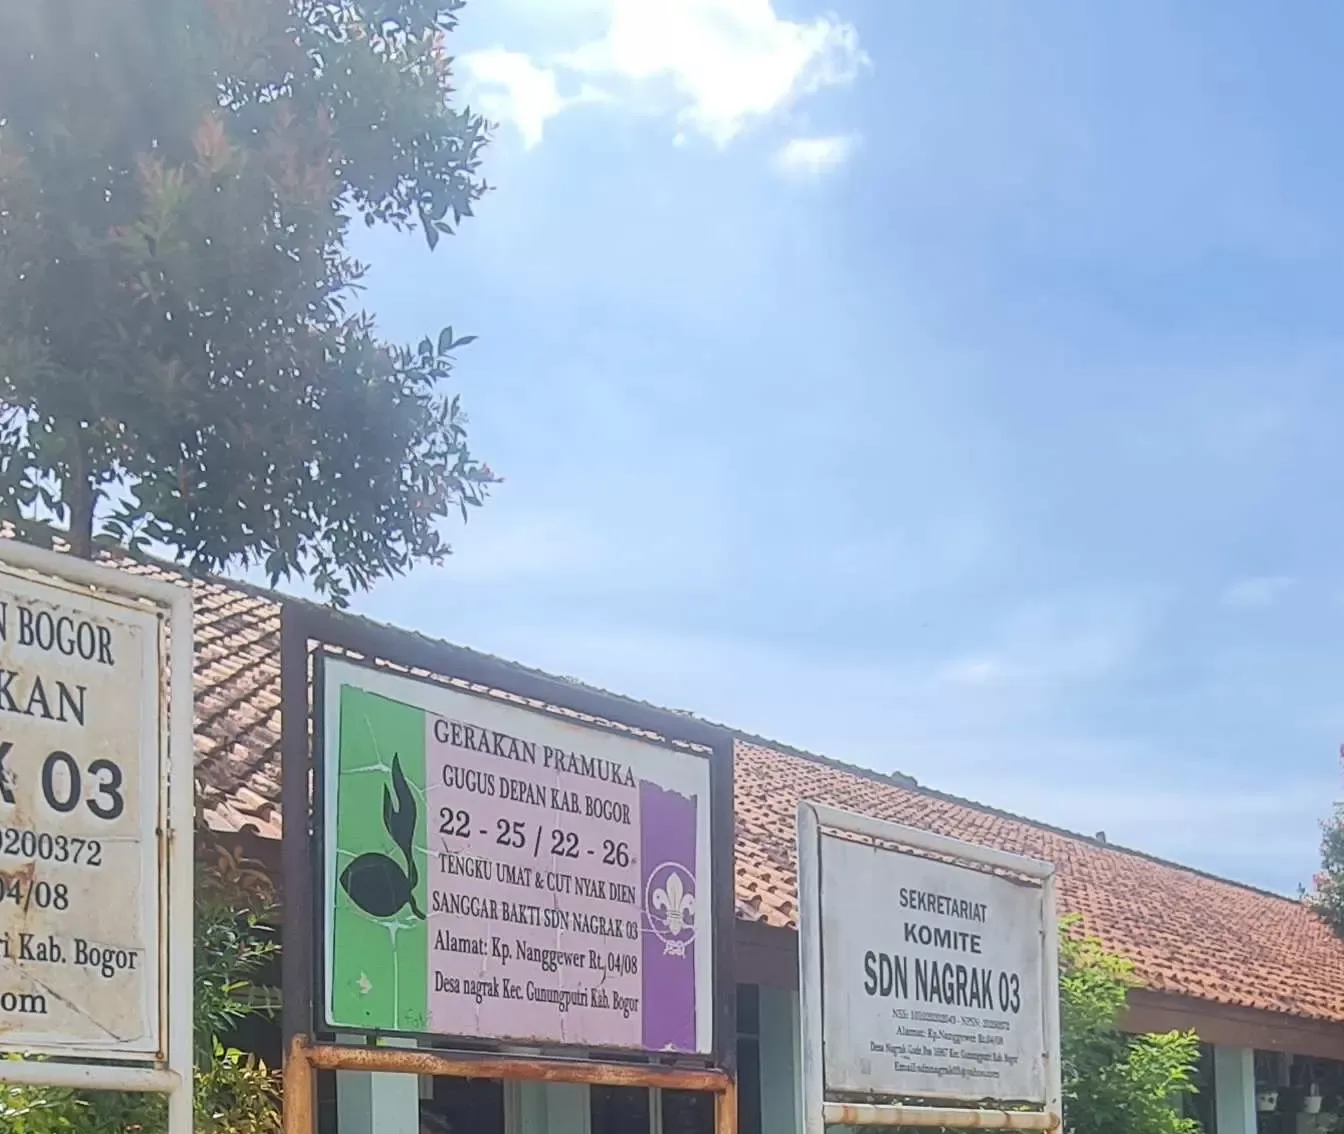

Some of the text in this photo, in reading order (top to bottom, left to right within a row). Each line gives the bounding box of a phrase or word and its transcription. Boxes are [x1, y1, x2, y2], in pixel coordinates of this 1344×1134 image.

[18, 605, 115, 666] BOGOR
[434, 719, 637, 788] GERAKAN PRAMUKA
[41, 750, 125, 821] 03
[442, 764, 631, 825] GUGUS DEPAN KAB. BOGOR
[439, 807, 471, 838] 22
[496, 818, 526, 848] 25
[533, 825, 543, 857] /
[550, 829, 580, 859] 22
[602, 839, 630, 868] 26
[439, 853, 637, 905] TENGKU UMAT & CUT NYAK DIEN
[432, 890, 639, 941] SANGGAR BAKTI SDN NAGRAK 03
[899, 887, 988, 924] SEKRETARIAT
[17, 932, 67, 964] Kab.
[73, 939, 138, 979] Bogor
[434, 929, 488, 956] Alamat:
[491, 936, 513, 966] Kp.
[516, 939, 585, 973] Nanggewer
[607, 952, 638, 976] 04/08
[903, 922, 983, 954] KOMITE
[434, 970, 460, 993] Desa
[463, 976, 499, 1004] nagrak
[502, 978, 524, 1001] Kec.
[864, 950, 1021, 1014] SDN NAGRAK 03
